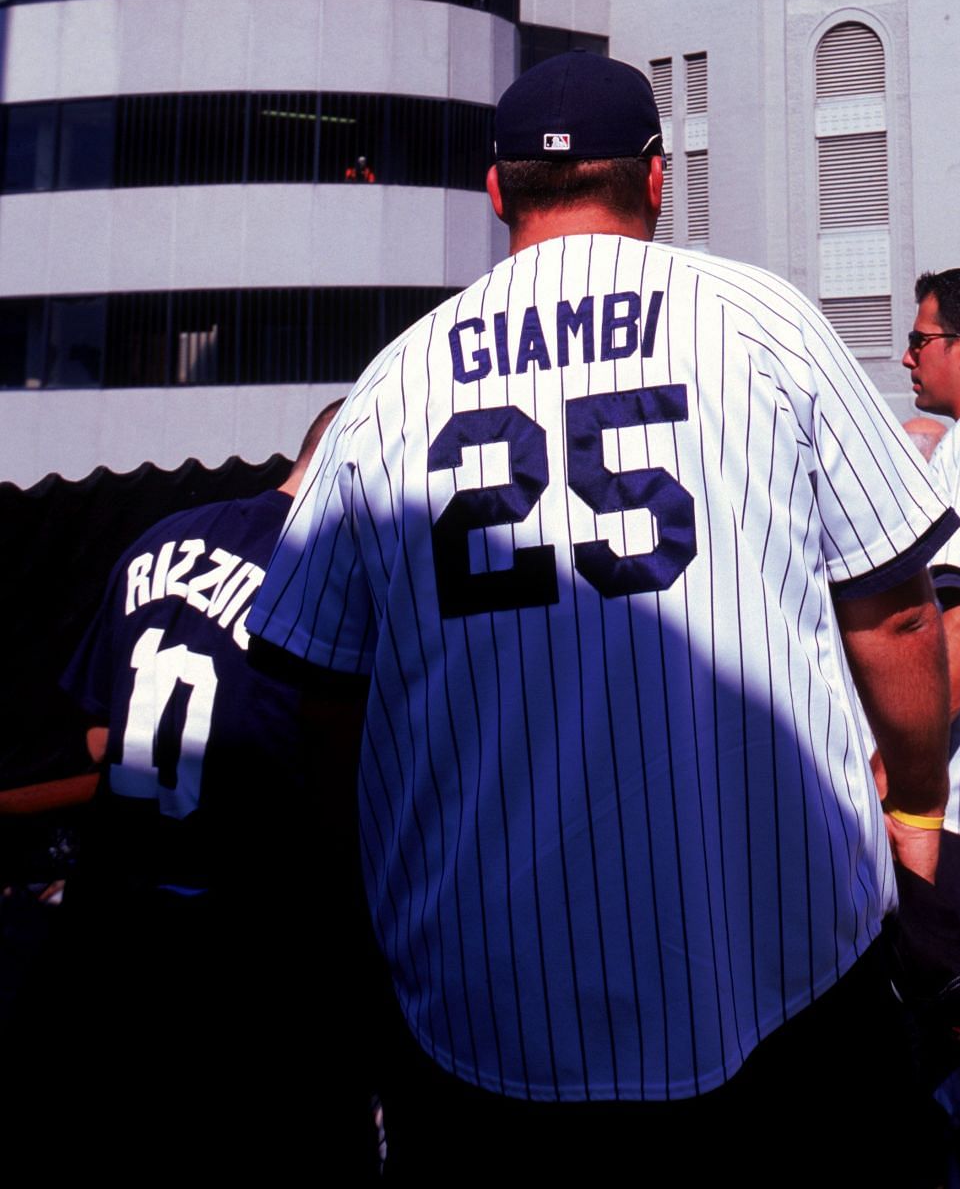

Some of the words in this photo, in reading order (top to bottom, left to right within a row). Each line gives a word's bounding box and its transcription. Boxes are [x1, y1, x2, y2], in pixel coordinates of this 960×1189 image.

[447, 290, 664, 385] GIAMBI
[427, 383, 698, 619] 25
[109, 627, 218, 821] 10
